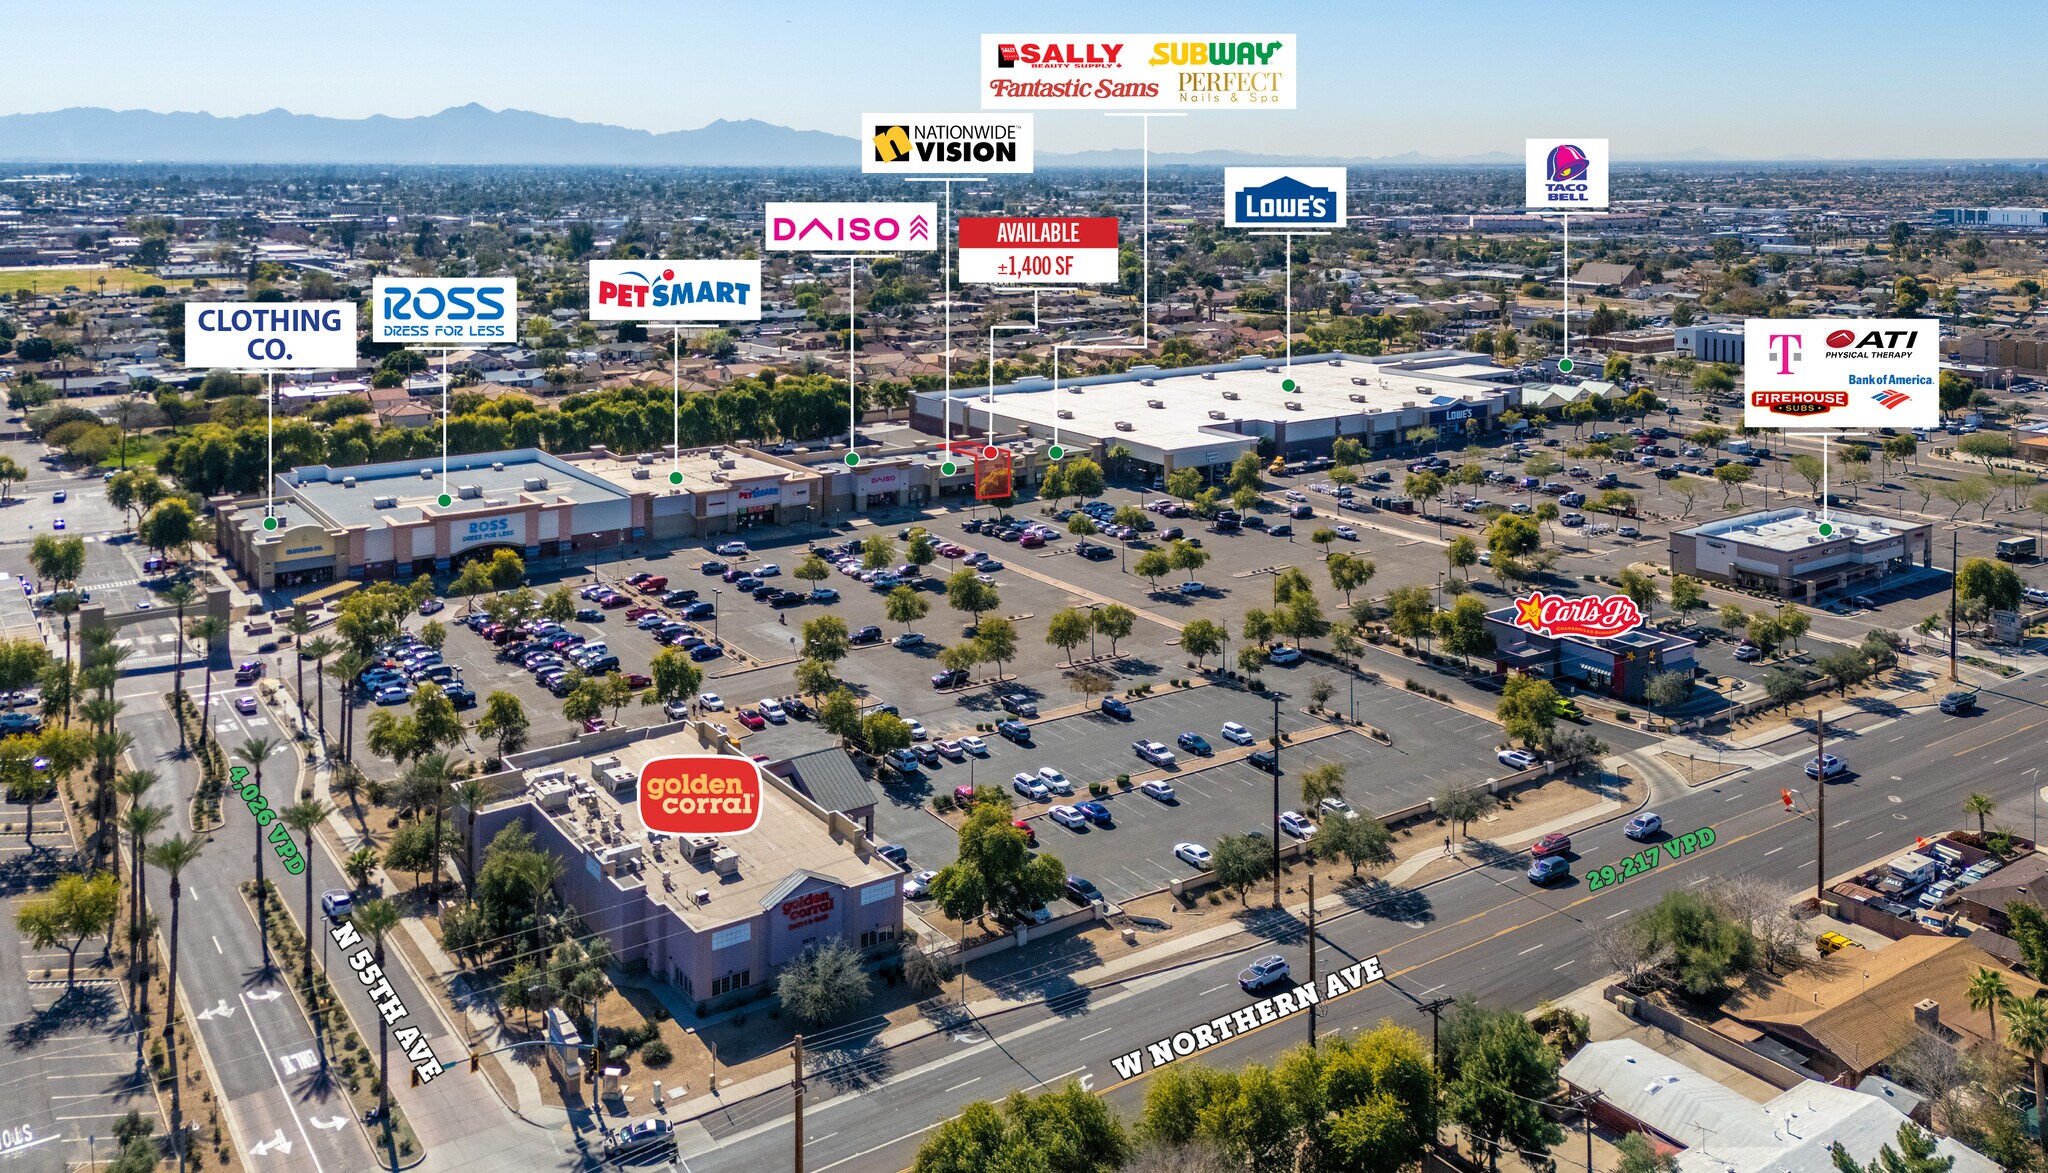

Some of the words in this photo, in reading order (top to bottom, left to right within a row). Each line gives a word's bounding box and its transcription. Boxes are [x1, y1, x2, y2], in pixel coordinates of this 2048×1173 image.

[1446, 408, 1473, 421] LOWE'S
[469, 518, 508, 534] ROSS
[783, 891, 829, 916] golden
[790, 897, 834, 920] corral
[0, 1123, 33, 1149] STO
